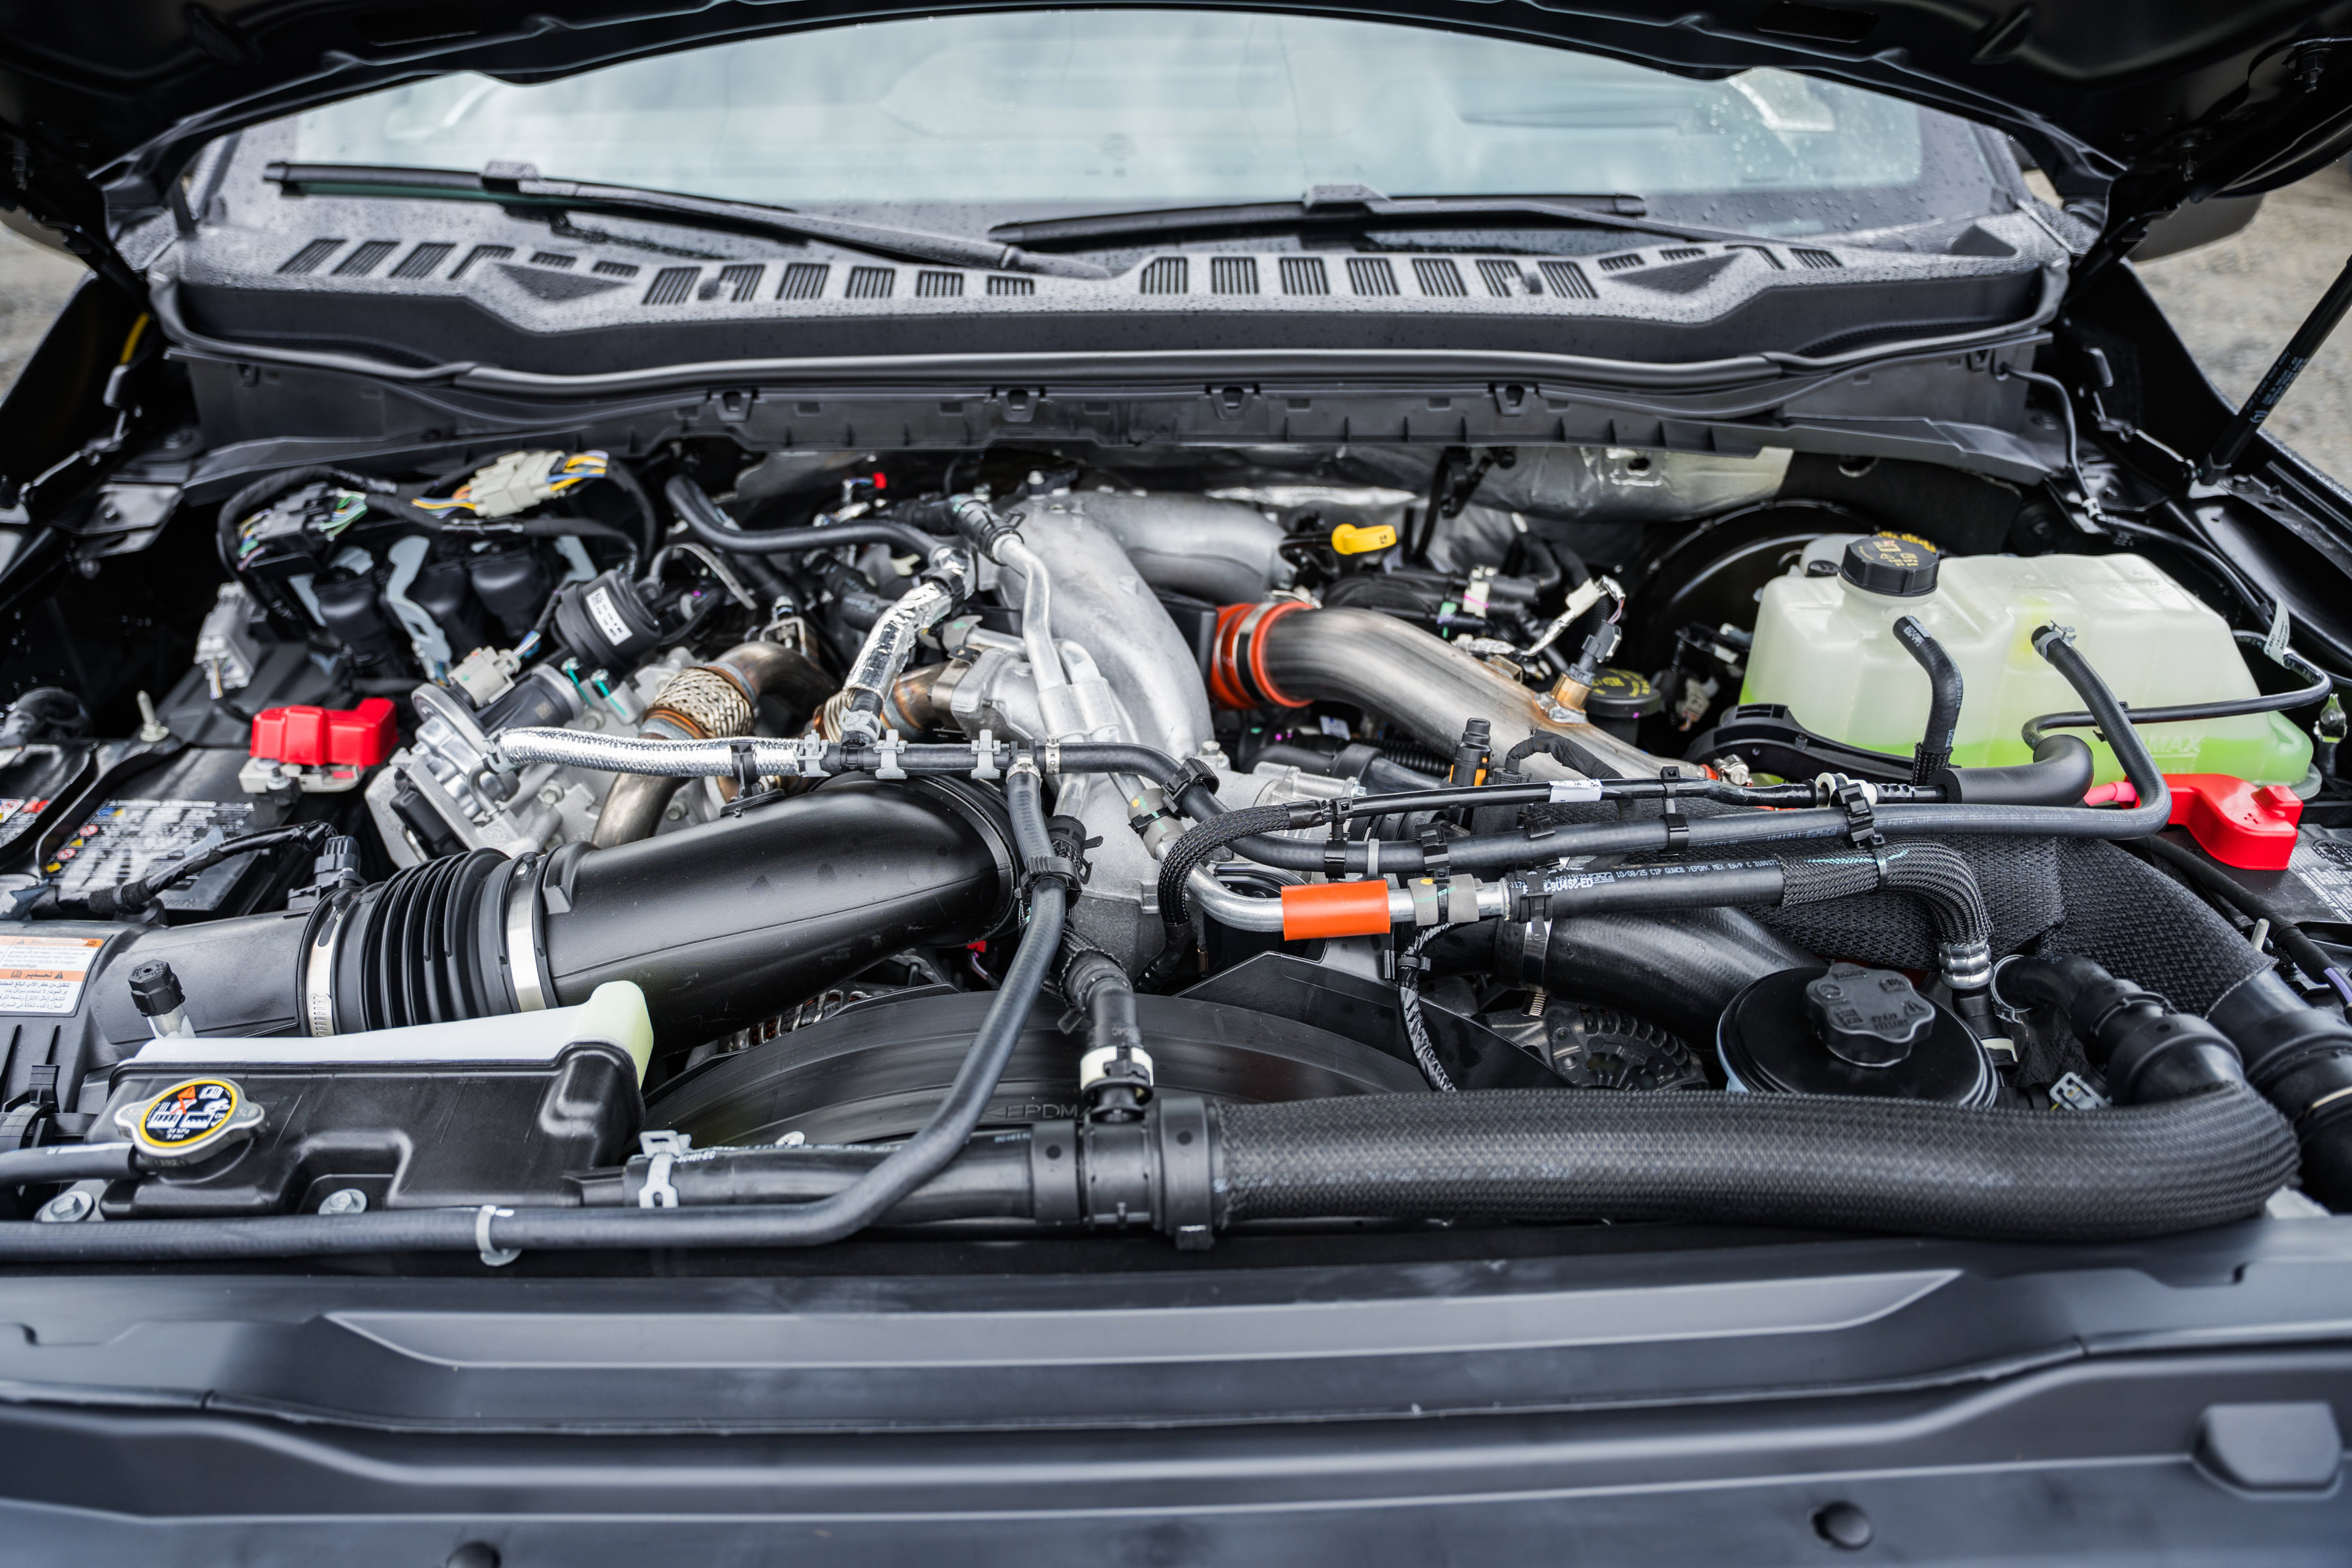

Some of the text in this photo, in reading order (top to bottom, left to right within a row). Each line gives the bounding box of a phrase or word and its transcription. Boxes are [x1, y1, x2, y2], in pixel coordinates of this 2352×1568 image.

[1767, 831, 1802, 841] 1041911
[1806, 826, 1837, 839] FoMoCo
[1589, 872, 1615, 883] FoMoCo
[1616, 869, 1648, 878] 10/08/25
